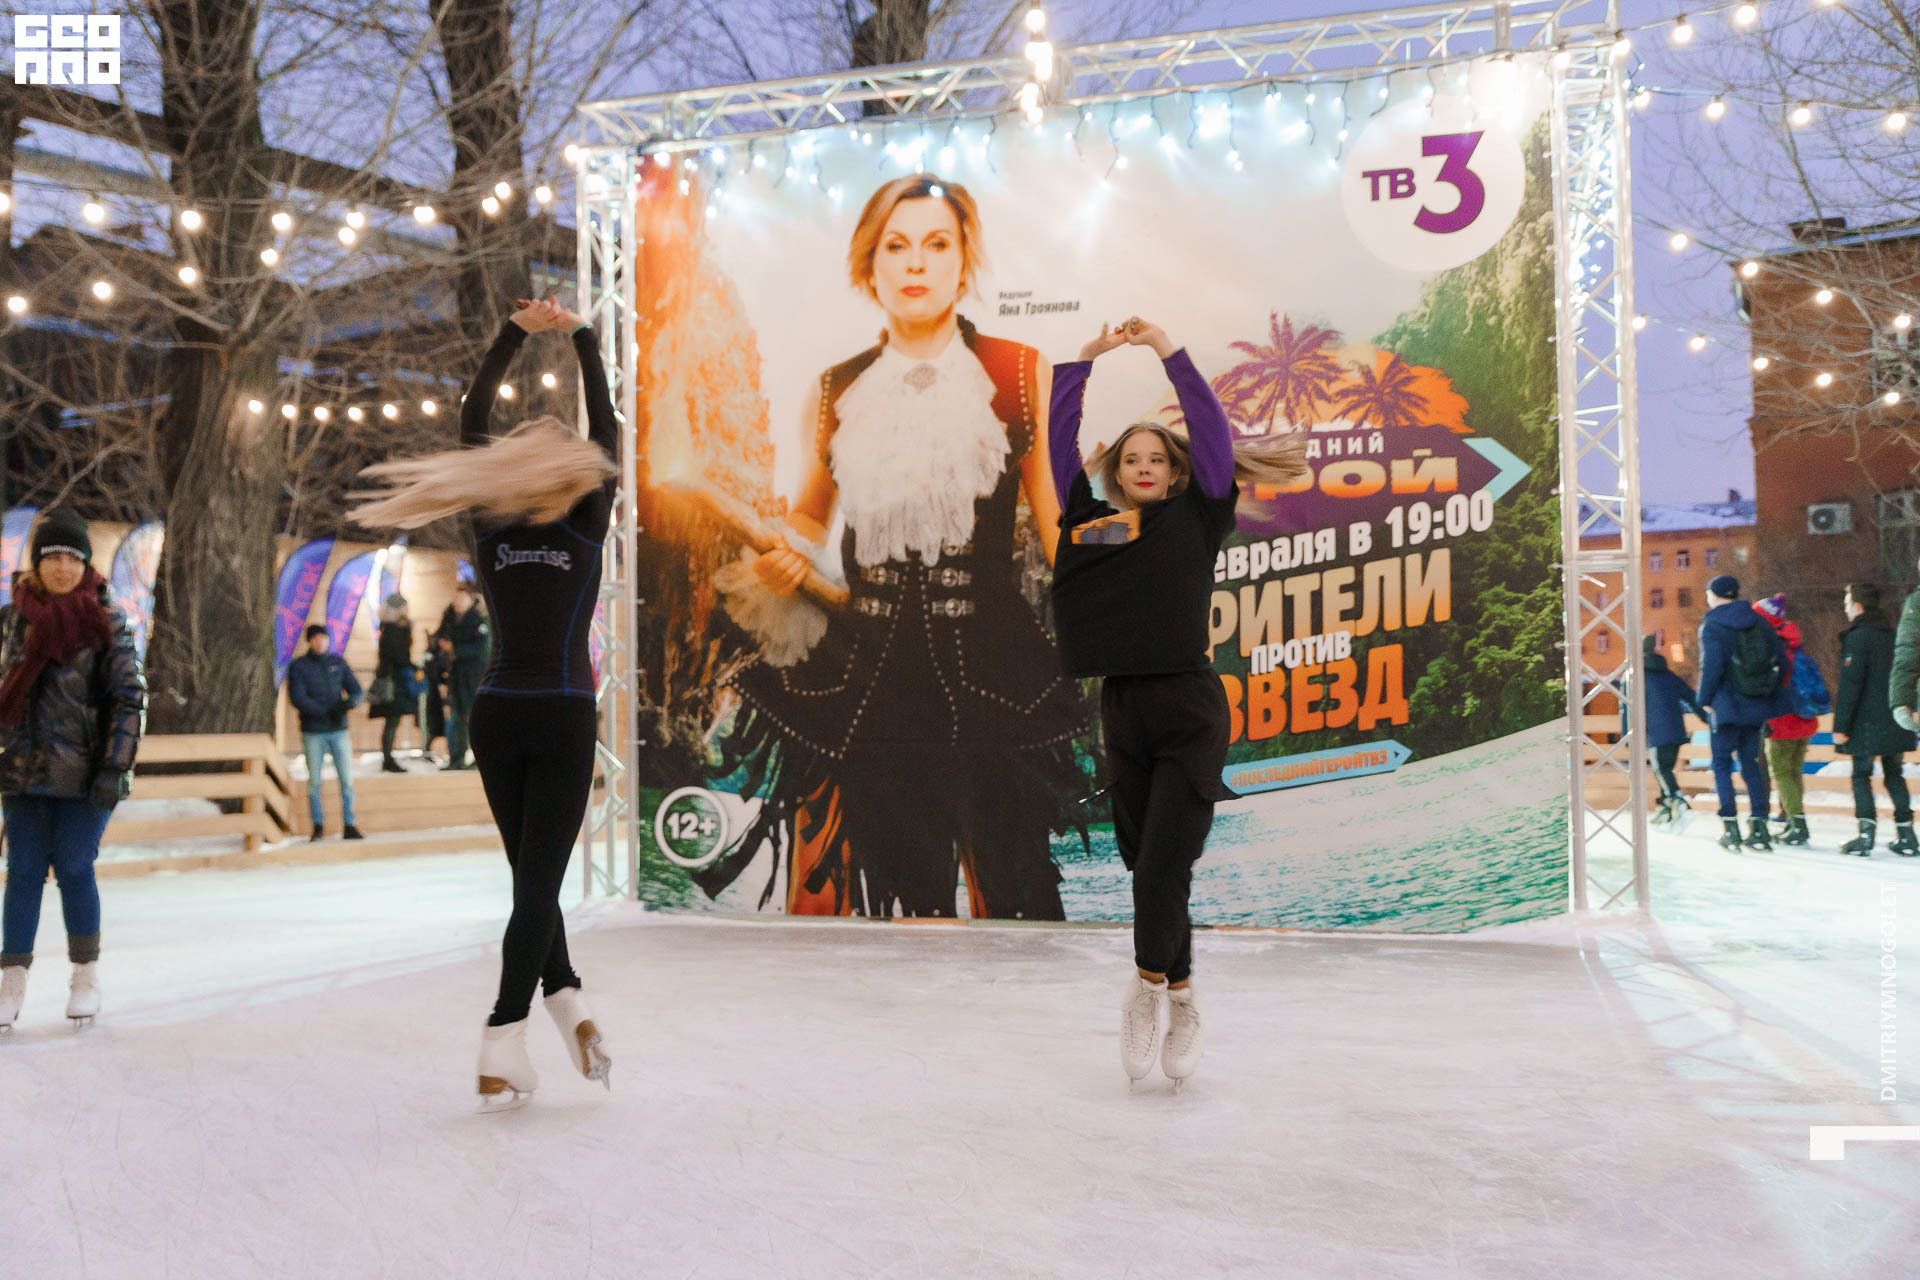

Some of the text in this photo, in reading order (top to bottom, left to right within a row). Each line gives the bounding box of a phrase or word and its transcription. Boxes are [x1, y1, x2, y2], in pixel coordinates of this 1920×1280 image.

[999, 301, 1080, 316] Яна Троянова
[1236, 449, 1458, 500] РОЙ
[494, 543, 573, 571] Sunrise
[1213, 527, 1336, 583] евраля
[1384, 489, 1494, 549] 19:00
[1206, 547, 1451, 663] РИТЕЛИ
[1250, 630, 1352, 676] ПРОТИВ
[666, 811, 717, 840] 12+
